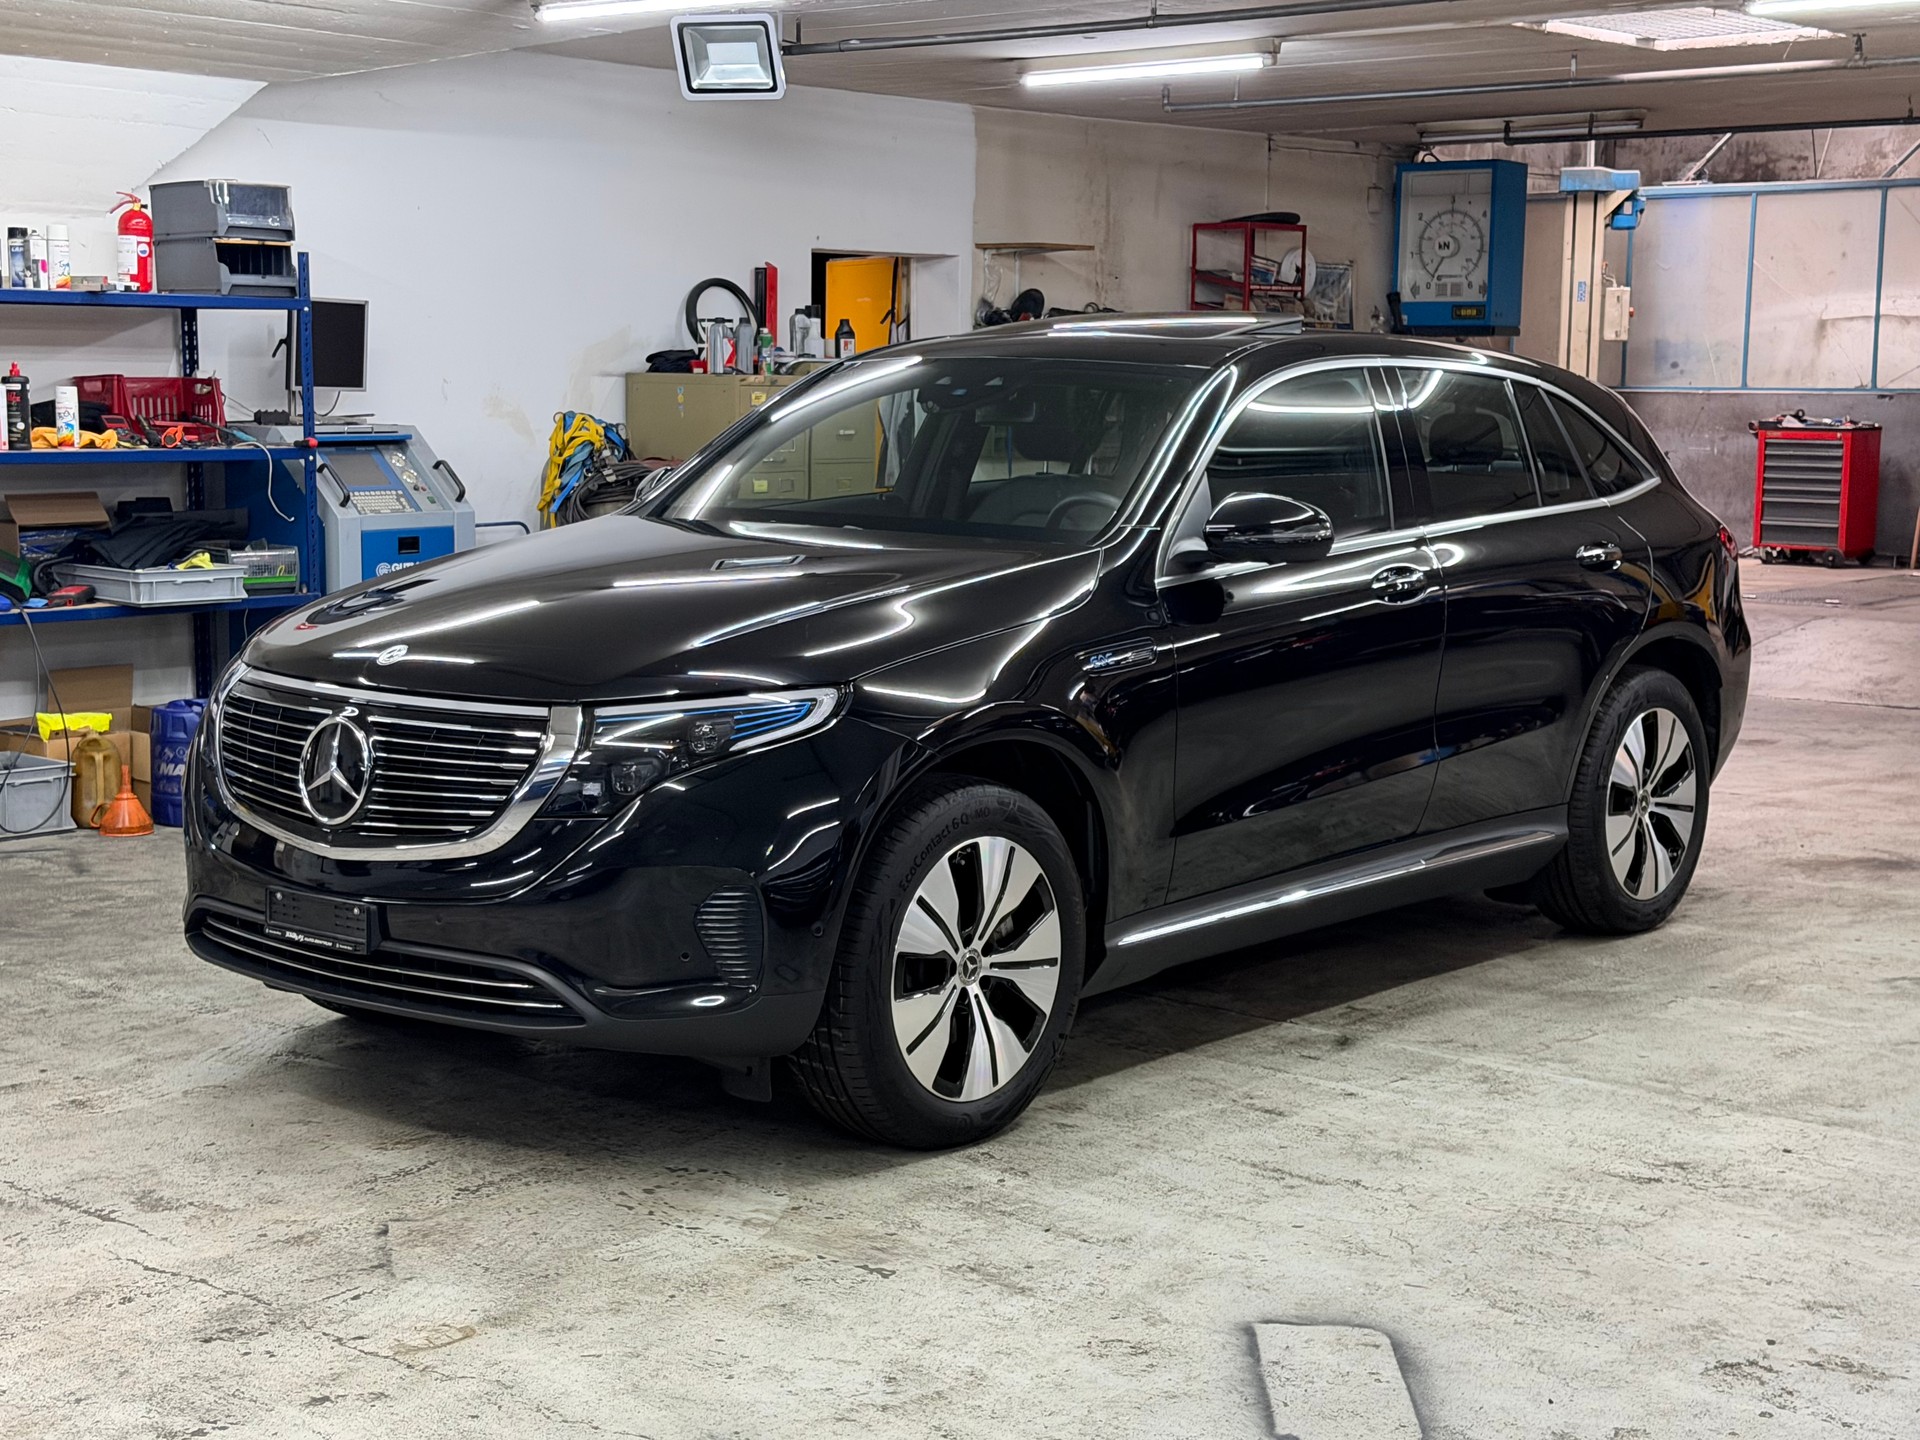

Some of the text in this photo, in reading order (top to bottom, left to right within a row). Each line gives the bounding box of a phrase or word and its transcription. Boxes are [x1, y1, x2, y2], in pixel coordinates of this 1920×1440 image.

[1417, 212, 1424, 221] 2
[1482, 209, 1488, 218] 4
[1438, 241, 1450, 250] kN
[900, 825, 952, 892] EcoContact
